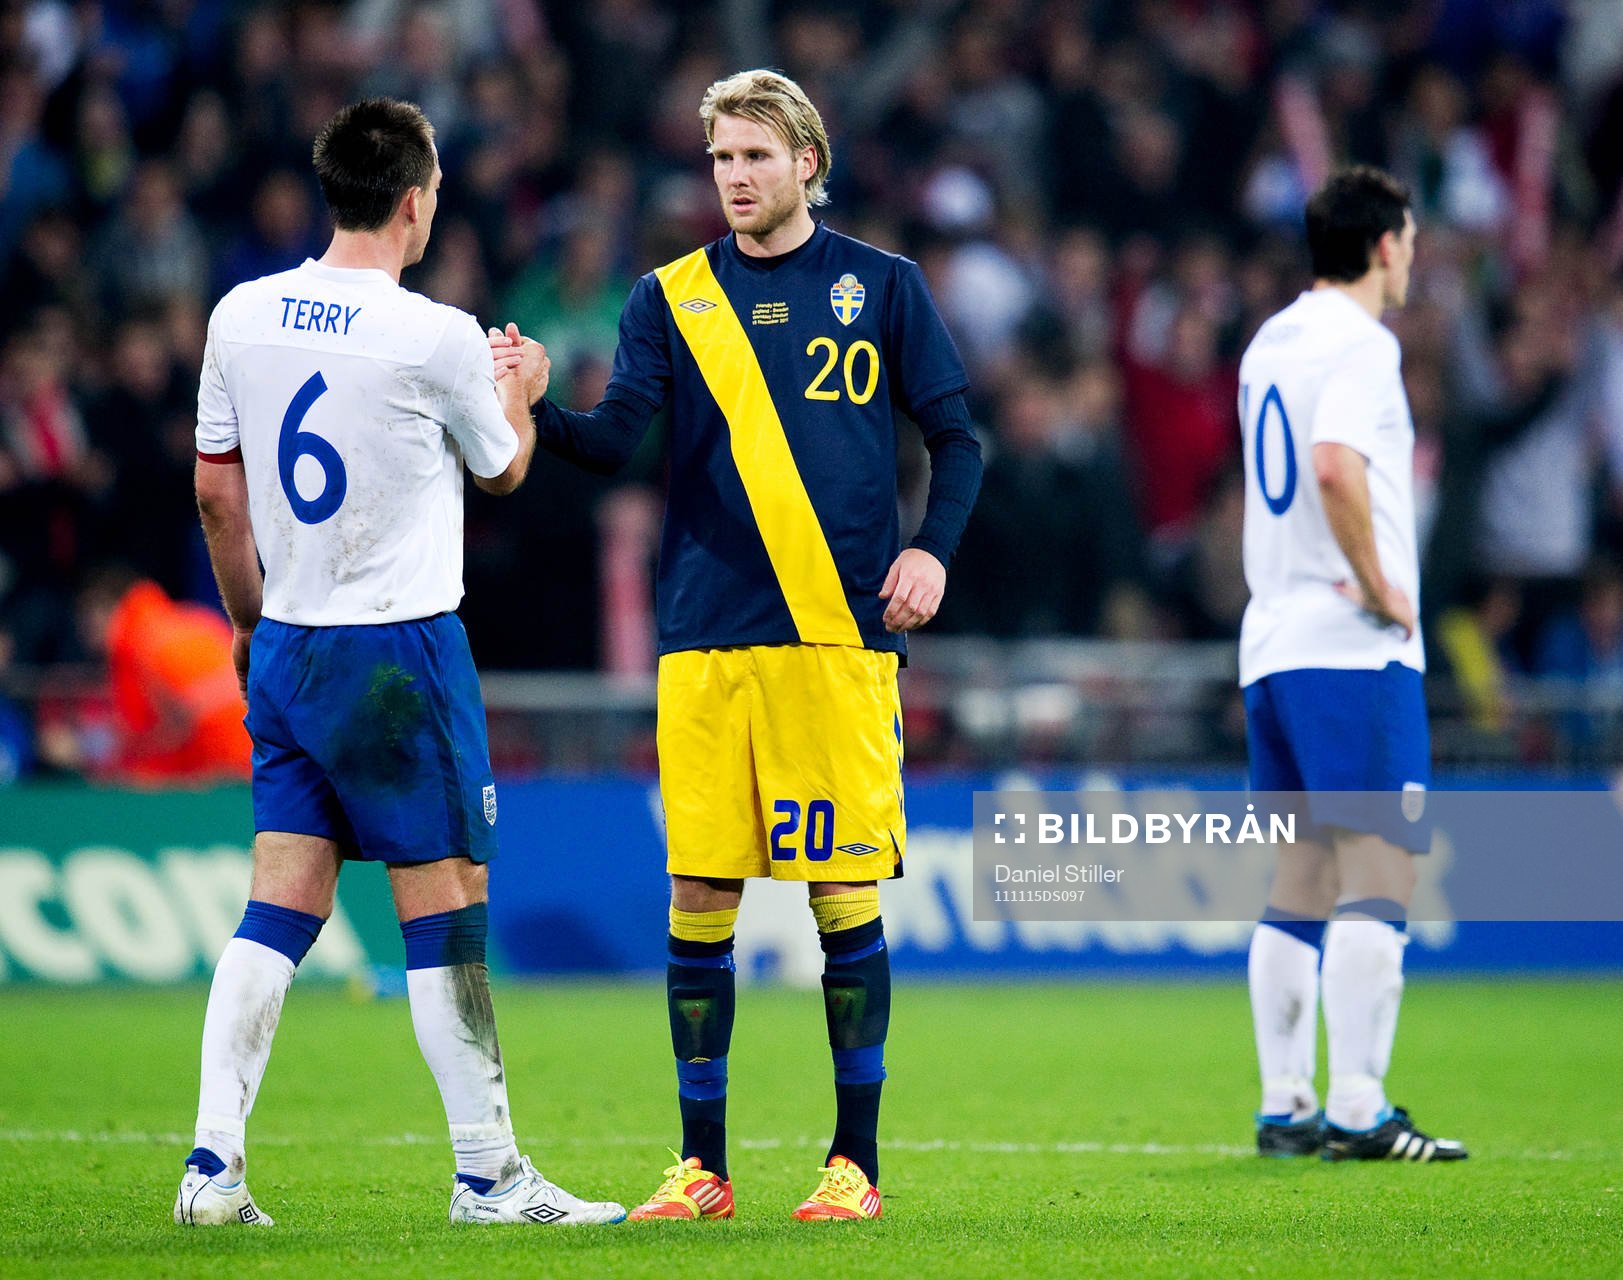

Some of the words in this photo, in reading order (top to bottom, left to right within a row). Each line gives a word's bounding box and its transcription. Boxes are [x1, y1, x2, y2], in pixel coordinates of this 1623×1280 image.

[281, 297, 362, 336] TERRY
[804, 336, 880, 405] 20
[278, 370, 348, 525] 6
[770, 799, 835, 862] 20
